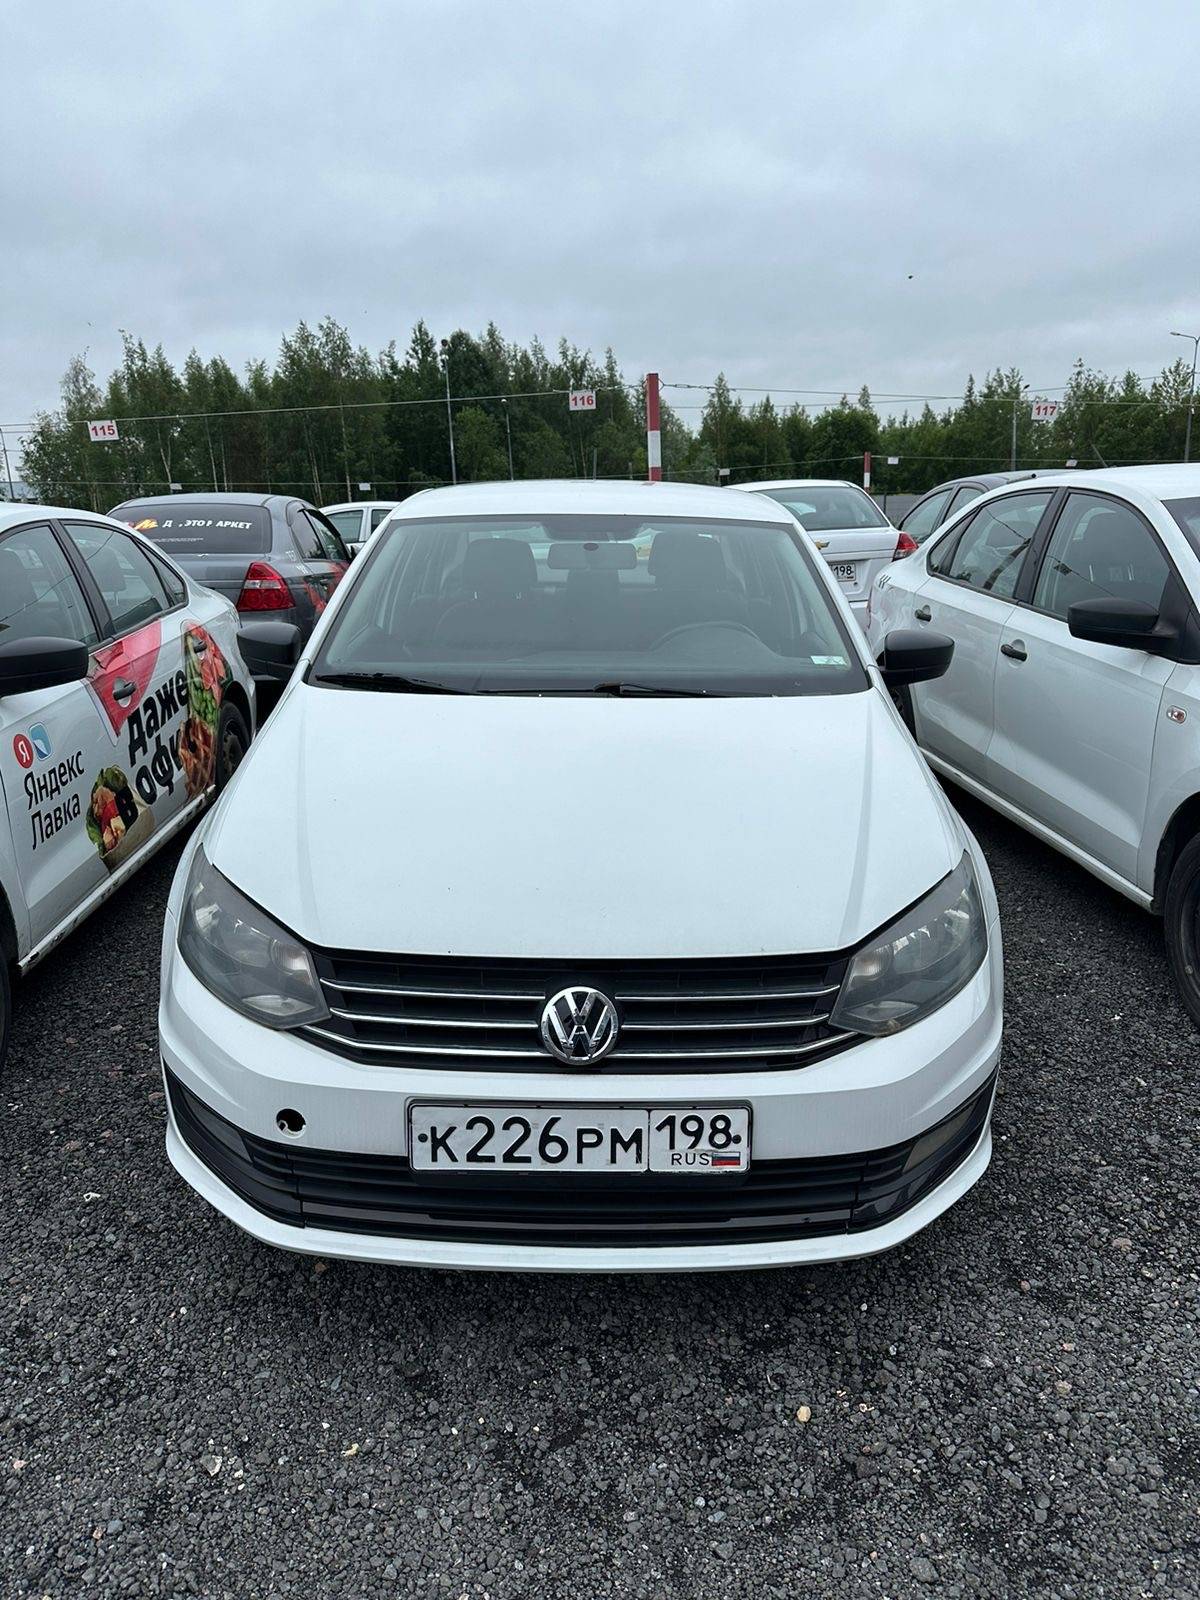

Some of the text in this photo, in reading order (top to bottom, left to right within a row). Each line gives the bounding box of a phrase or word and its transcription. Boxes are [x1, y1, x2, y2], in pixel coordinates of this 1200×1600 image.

[571, 395, 594, 406] 116
[1035, 405, 1057, 416] 117
[91, 425, 115, 436] 115
[833, 565, 852, 576] 198
[128, 669, 189, 768] Даже
[135, 718, 197, 805] офи
[23, 750, 85, 811] Яндекс
[30, 793, 81, 850] Лавка
[430, 1114, 733, 1165] К226РМ 198
[671, 1153, 710, 1166] RUS
